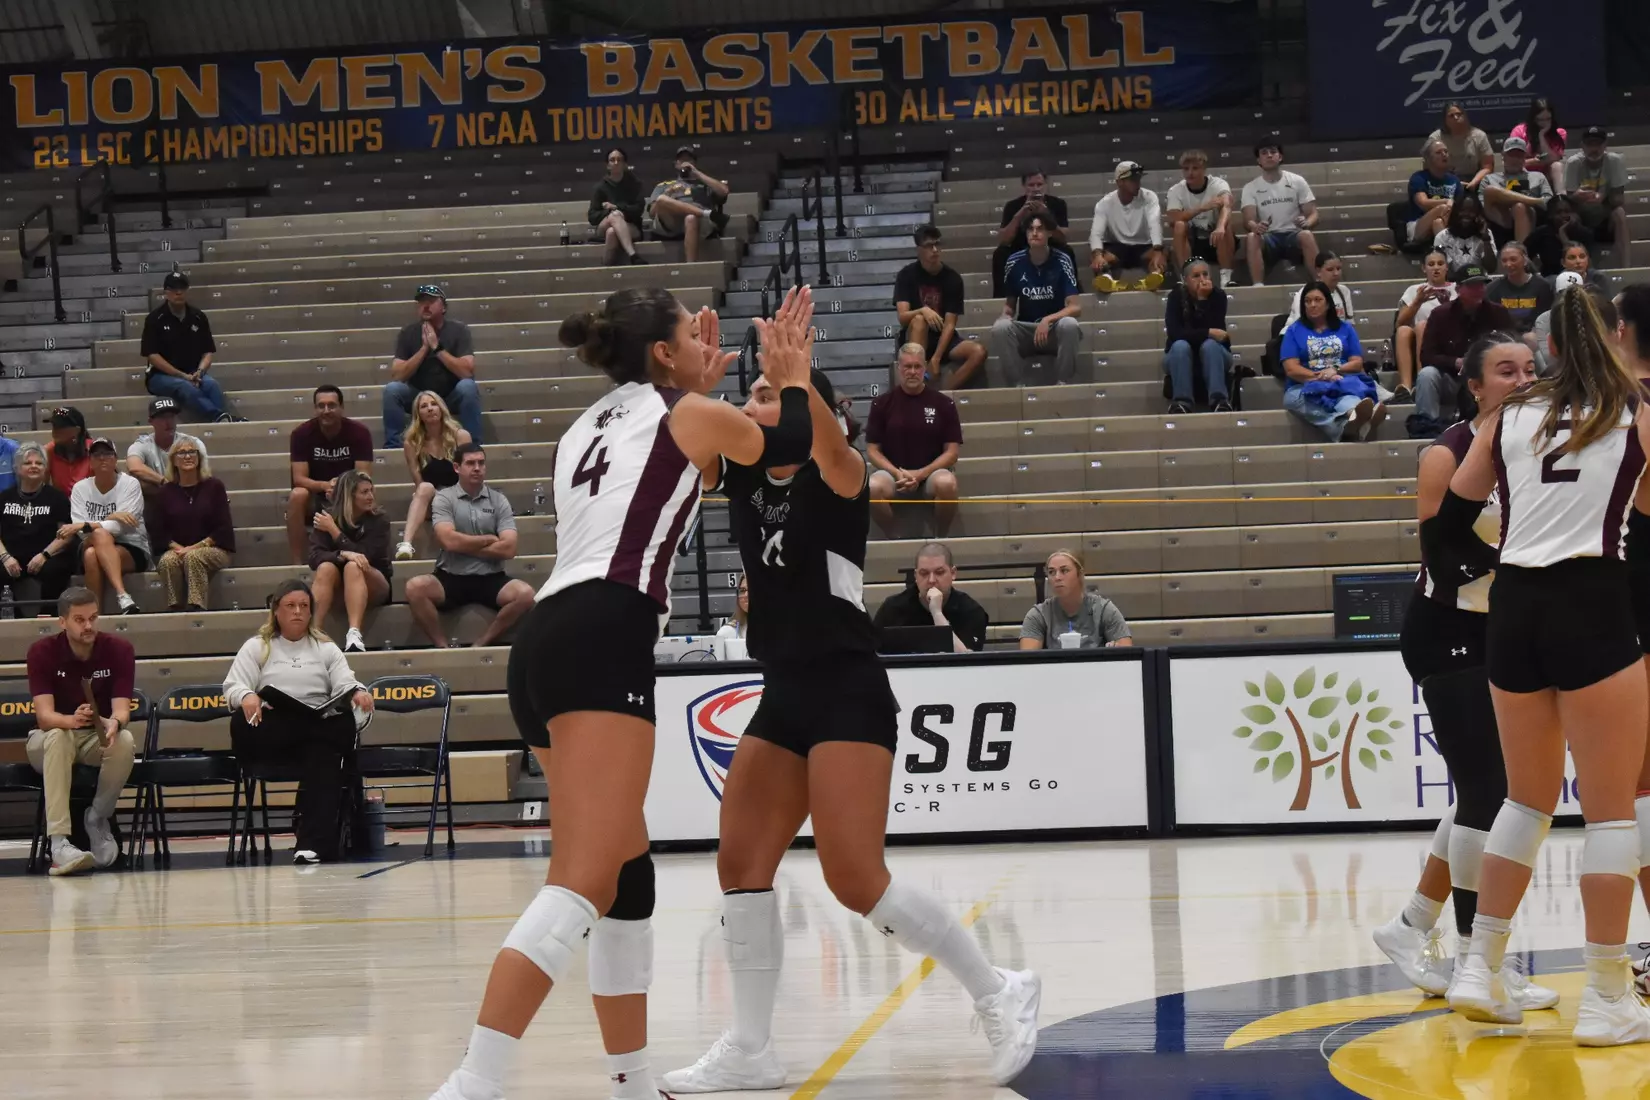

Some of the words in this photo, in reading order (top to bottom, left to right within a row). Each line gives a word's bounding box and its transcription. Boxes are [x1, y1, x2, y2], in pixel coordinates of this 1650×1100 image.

[9, 63, 219, 128] LION
[254, 45, 546, 116] MEN'S
[580, 11, 1175, 98] BASKETBALL
[1398, 38, 1538, 106] Feed
[899, 76, 1152, 123] ALL-AMERICANS
[428, 114, 445, 148] 7
[456, 110, 538, 146] NCAA
[547, 97, 772, 142] TOURNAMENTS
[80, 131, 132, 168] LSC
[144, 118, 383, 163] CHAMPIONSHIPS
[848, 250, 857, 261] 15
[833, 275, 843, 286] 14
[108, 287, 117, 298] 15
[1022, 285, 1054, 297] QATAR
[831, 301, 841, 312] 13
[816, 329, 826, 340] 12
[45, 338, 55, 349] 13
[15, 366, 25, 378] 12
[155, 399, 174, 409] SIU
[313, 446, 355, 458] SALUKI
[1541, 419, 1581, 484] 2
[571, 434, 611, 497] 4
[86, 500, 117, 516] SOUTHER
[729, 573, 736, 587] 5
[93, 669, 111, 679] SIU
[373, 684, 436, 701] LIONS
[904, 701, 1017, 774] SG
